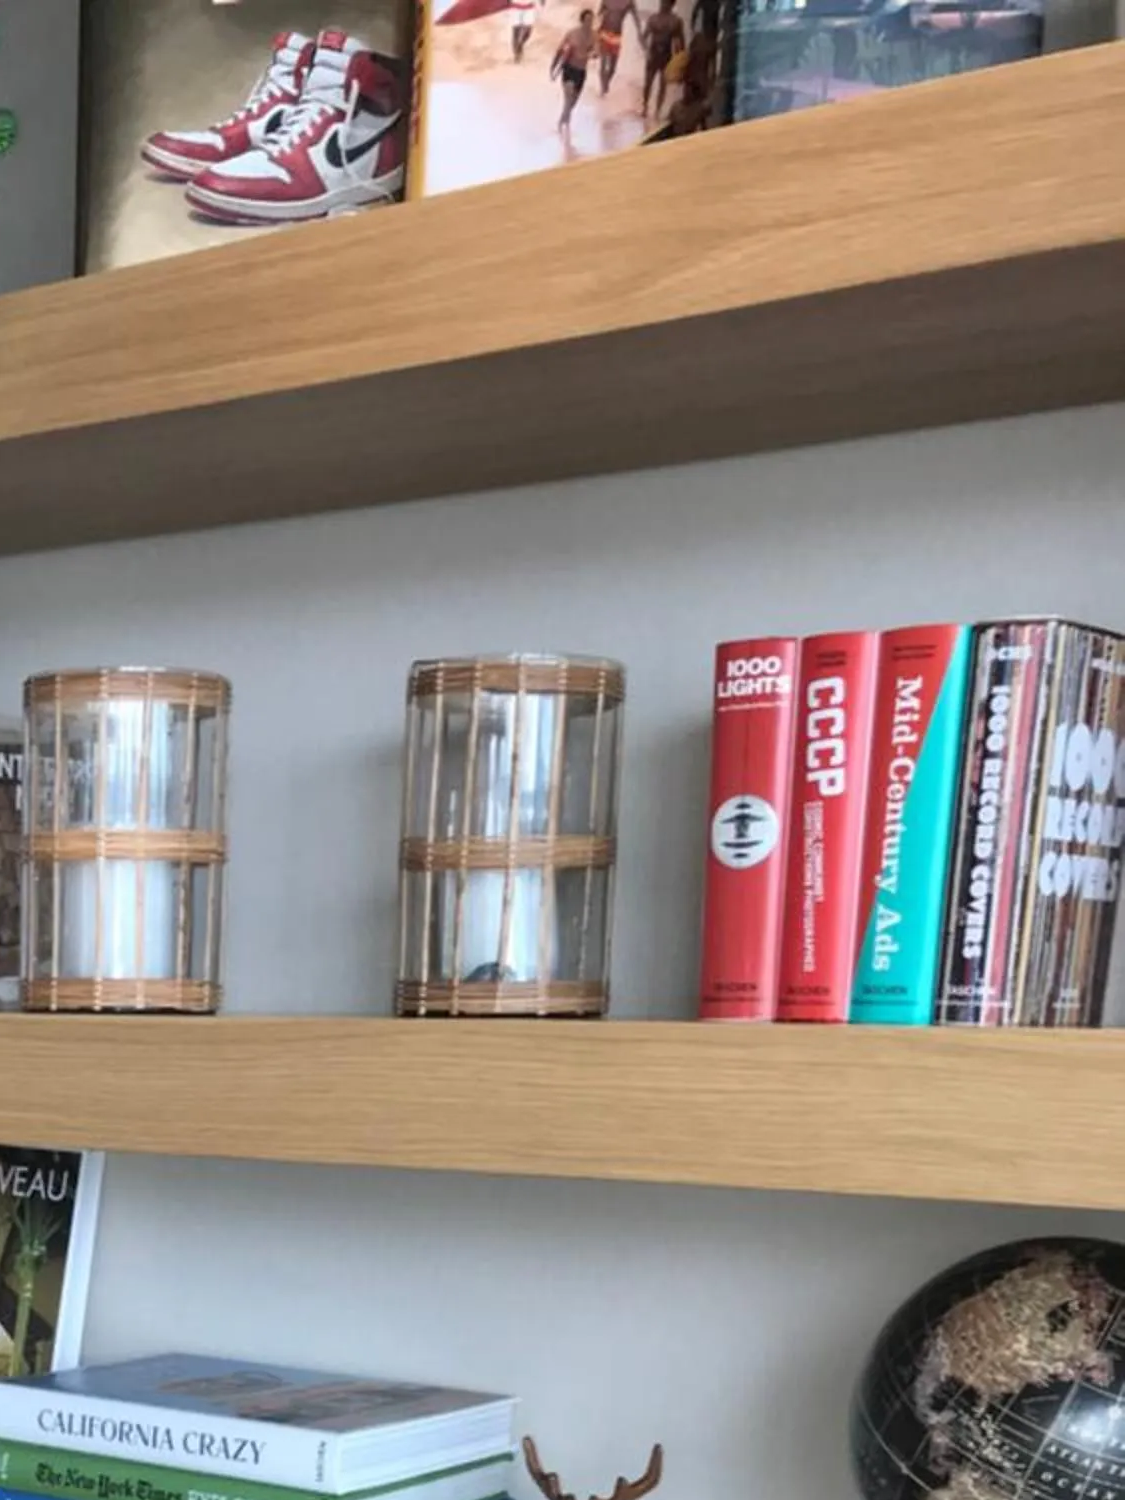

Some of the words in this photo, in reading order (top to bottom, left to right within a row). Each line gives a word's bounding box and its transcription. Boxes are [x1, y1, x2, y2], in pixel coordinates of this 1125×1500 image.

[718, 675, 791, 698] LIGHTS
[726, 656, 781, 677] 1000
[806, 677, 846, 797] CCCP
[984, 685, 1010, 752] 1000
[875, 677, 923, 893] Mid-Century
[974, 757, 1003, 858] RECORD
[872, 901, 901, 972] Ads
[961, 864, 991, 960] COVERS
[37, 1408, 174, 1452] CALIFORNIA
[182, 1431, 267, 1465] CRAZY
[35, 1462, 63, 1485] The
[65, 1469, 96, 1491] New
[97, 1474, 135, 1499] York
